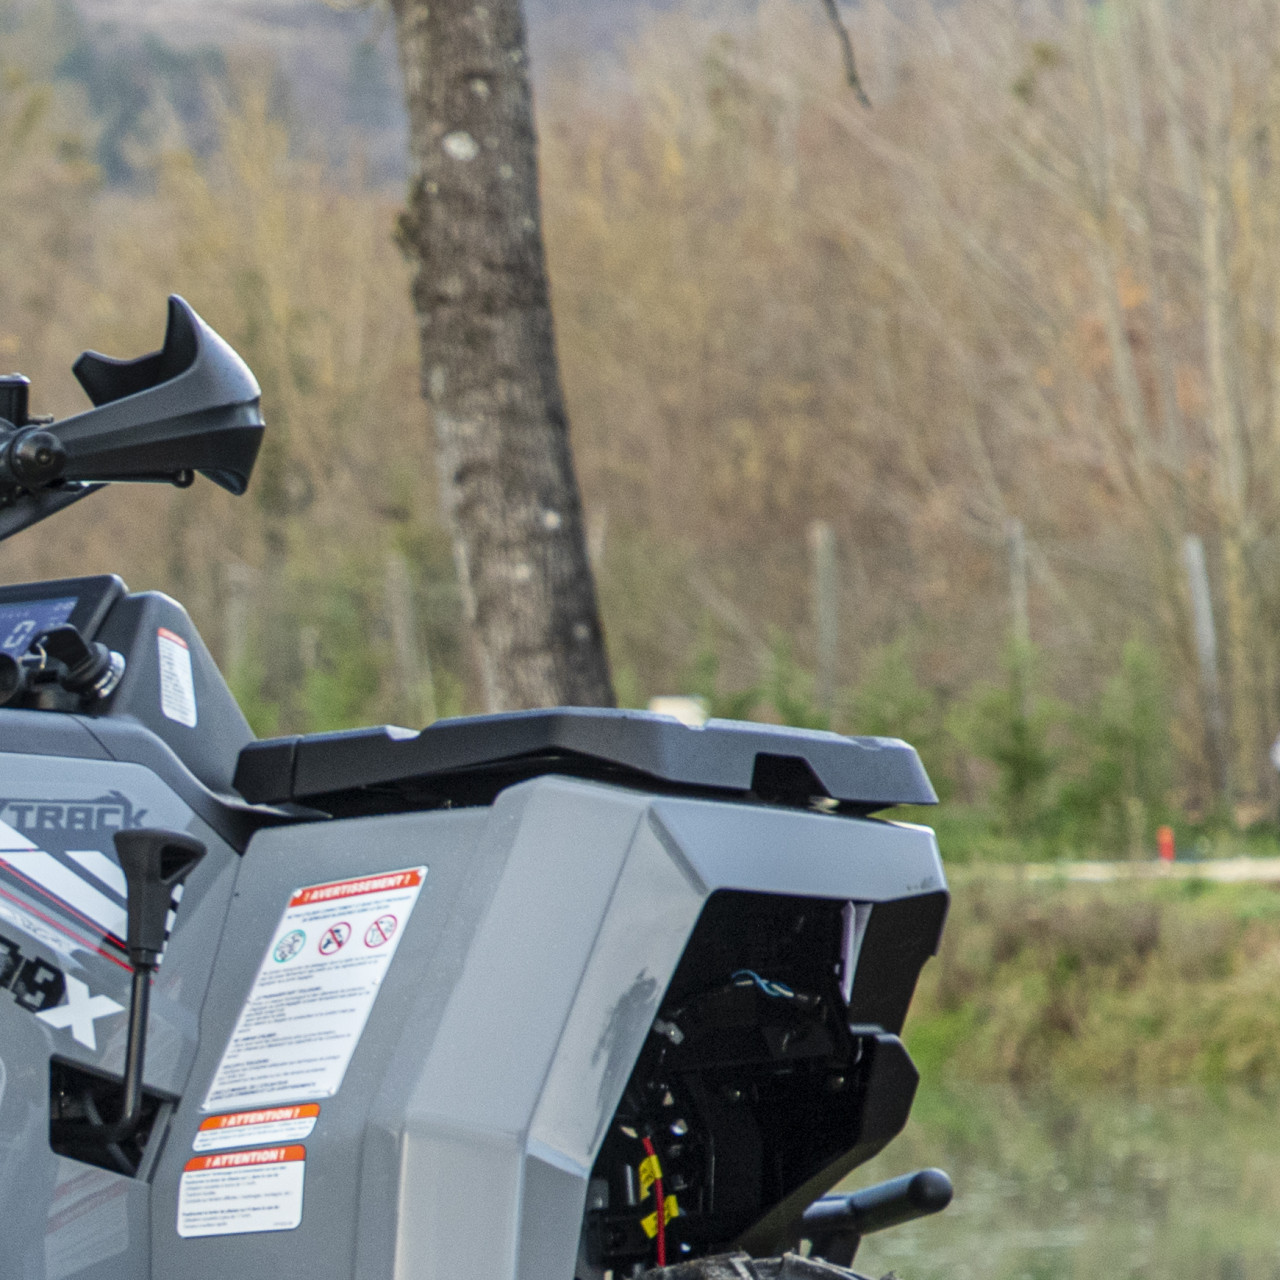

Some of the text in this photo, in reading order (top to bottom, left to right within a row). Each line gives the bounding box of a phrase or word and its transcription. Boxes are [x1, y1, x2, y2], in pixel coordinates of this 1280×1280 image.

[310, 875, 404, 900] AVERTISSEMENT
[227, 1109, 293, 1126] ATTENTION
[212, 1150, 278, 1167] ATTENTION
